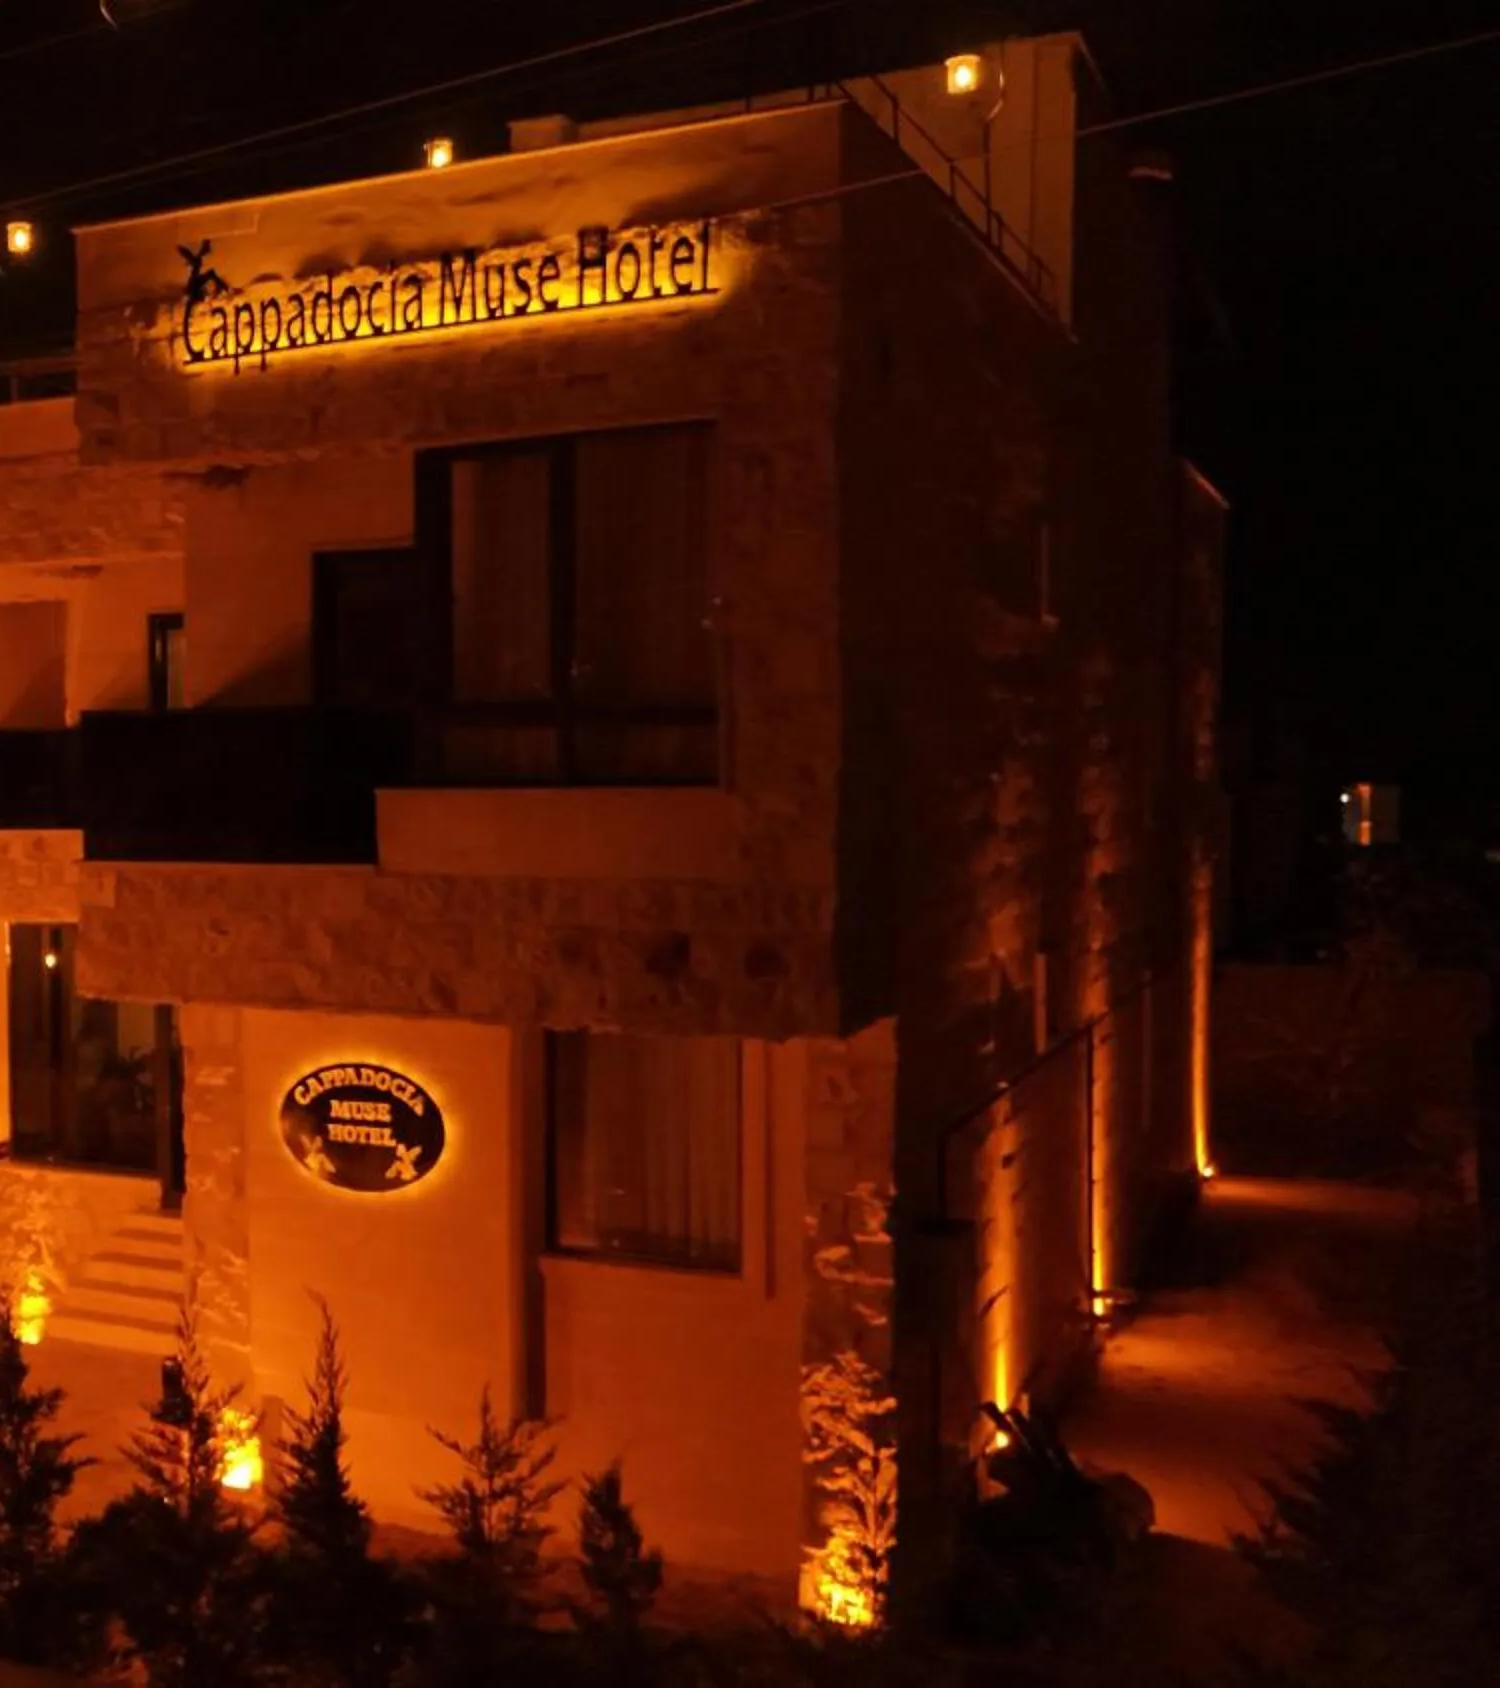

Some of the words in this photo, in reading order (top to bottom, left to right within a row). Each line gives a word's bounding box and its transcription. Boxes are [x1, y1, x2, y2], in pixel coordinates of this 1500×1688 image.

[183, 260, 423, 374] Cappadocia
[439, 247, 561, 318] Muse
[577, 222, 716, 302] Hotel
[294, 1067, 424, 1116] CAPPADOCIA
[330, 1099, 392, 1122] MUSE
[327, 1123, 397, 1146] HOTEL
